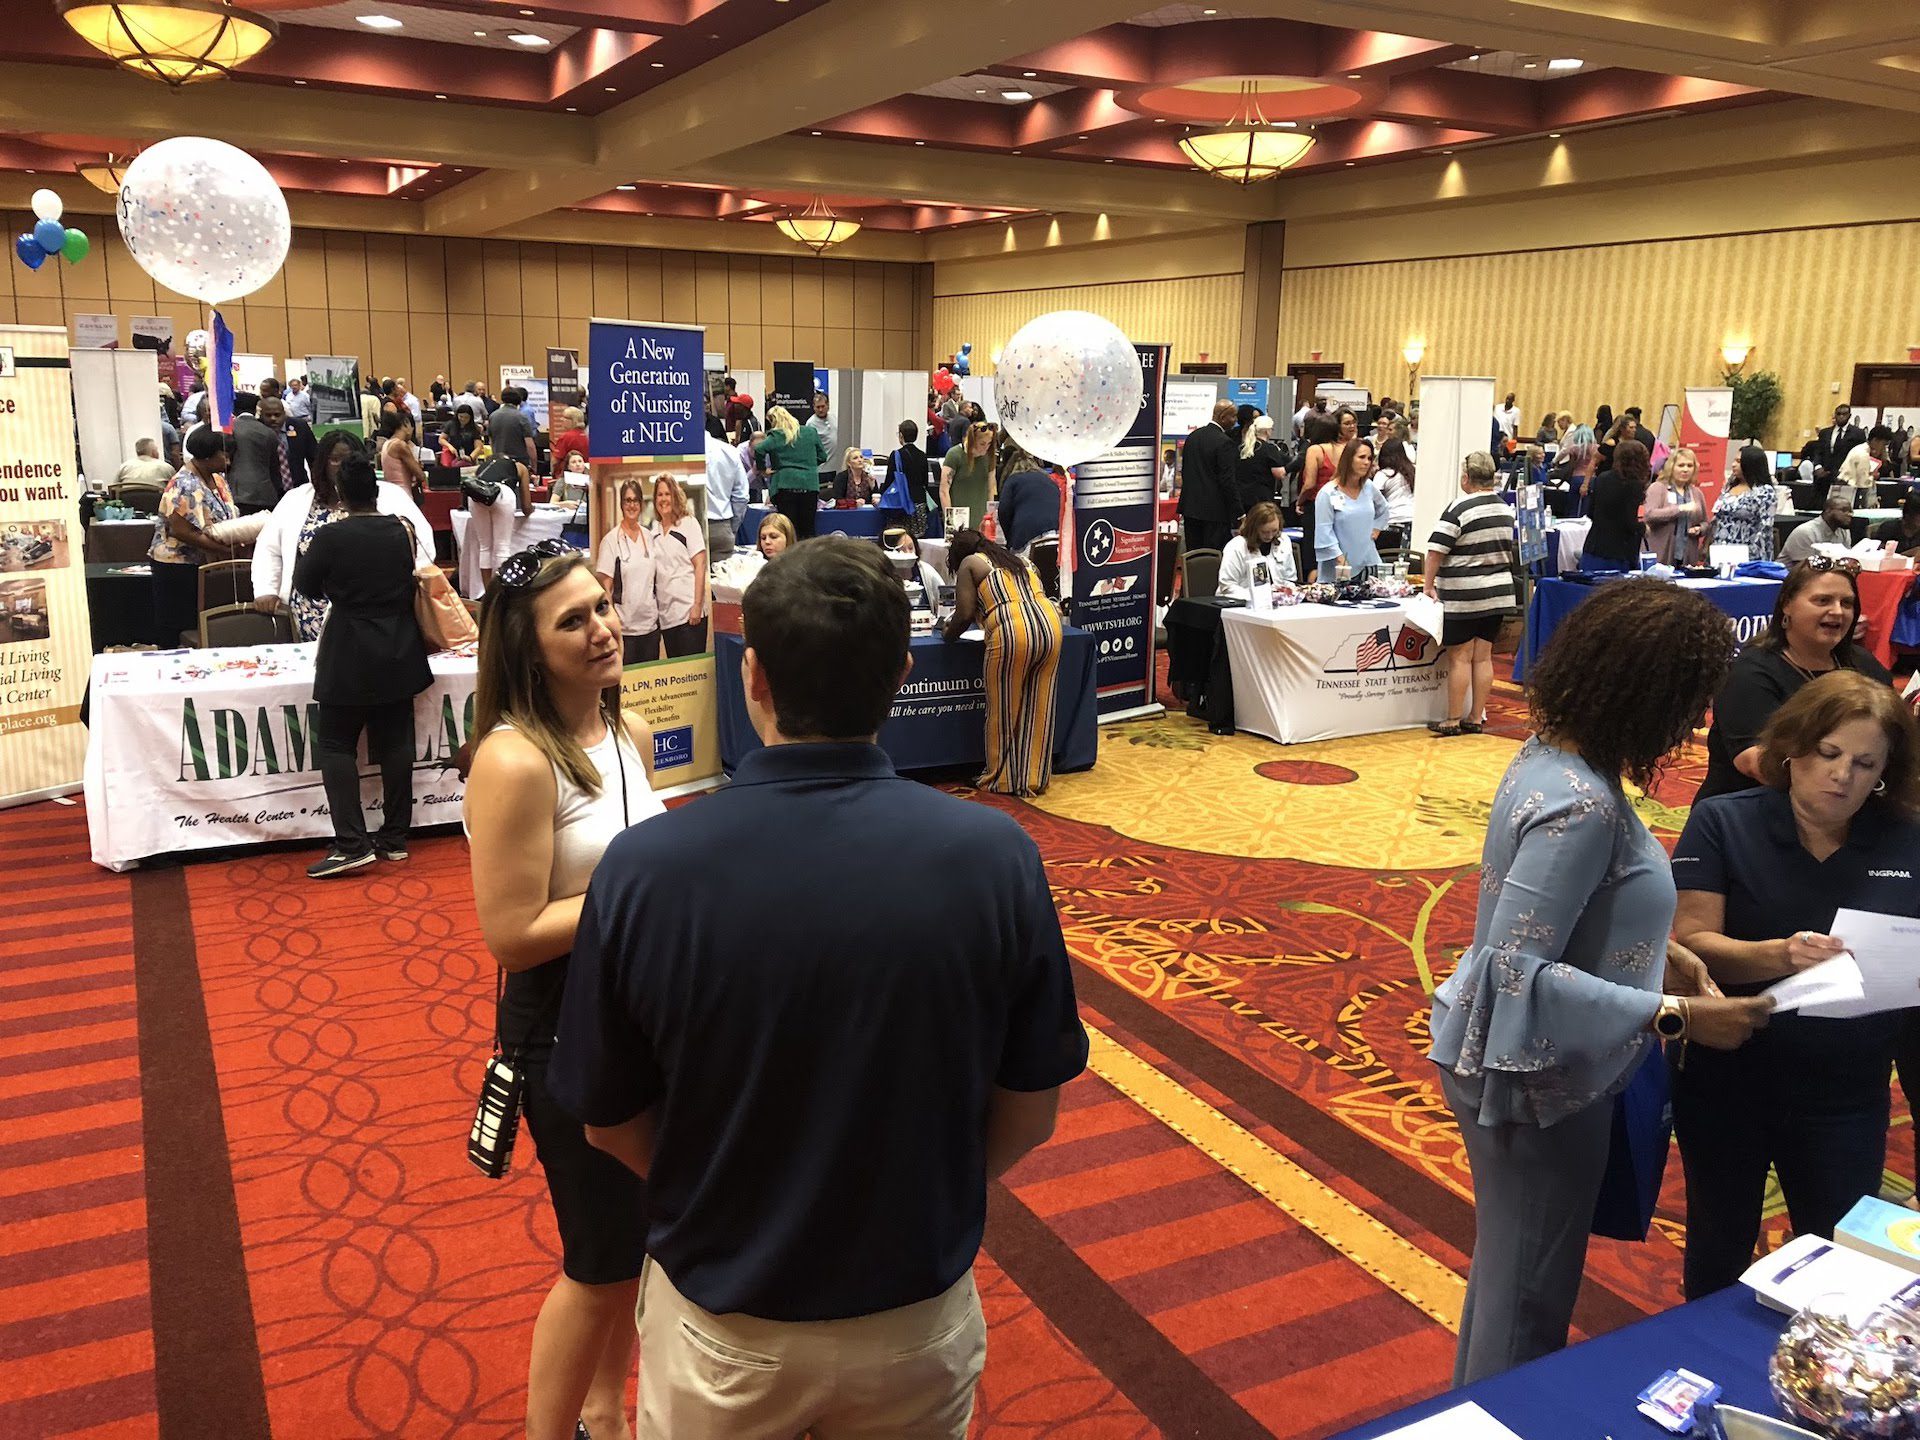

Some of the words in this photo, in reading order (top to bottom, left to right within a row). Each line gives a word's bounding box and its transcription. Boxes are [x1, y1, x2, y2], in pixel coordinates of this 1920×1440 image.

[624, 337, 637, 360] A
[641, 338, 675, 361] New
[510, 367, 532, 375] ELAM
[609, 361, 690, 386] Generation
[236, 383, 256, 391] LITY
[610, 390, 628, 413] of
[632, 391, 692, 421] Nursing
[621, 428, 635, 443] at
[639, 421, 684, 443] NHC
[24, 481, 69, 501] want.
[1082, 615, 1143, 633] WWW.TSVH.ORG
[9, 650, 50, 665] Living
[21, 668, 62, 683] Living
[632, 681, 653, 693] LPN,
[655, 679, 669, 688] RN
[671, 672, 708, 685] Positions
[1436, 669, 1449, 680] HO
[7, 689, 51, 704] Center
[659, 690, 698, 702] Advancement
[645, 706, 674, 715] Flexibility
[903, 705, 917, 716] the
[918, 706, 937, 715] care
[938, 704, 953, 717] you
[955, 700, 975, 712] need
[176, 697, 322, 782] ADAM
[175, 814, 200, 828] The
[208, 805, 250, 824] Health
[253, 801, 297, 824] Center
